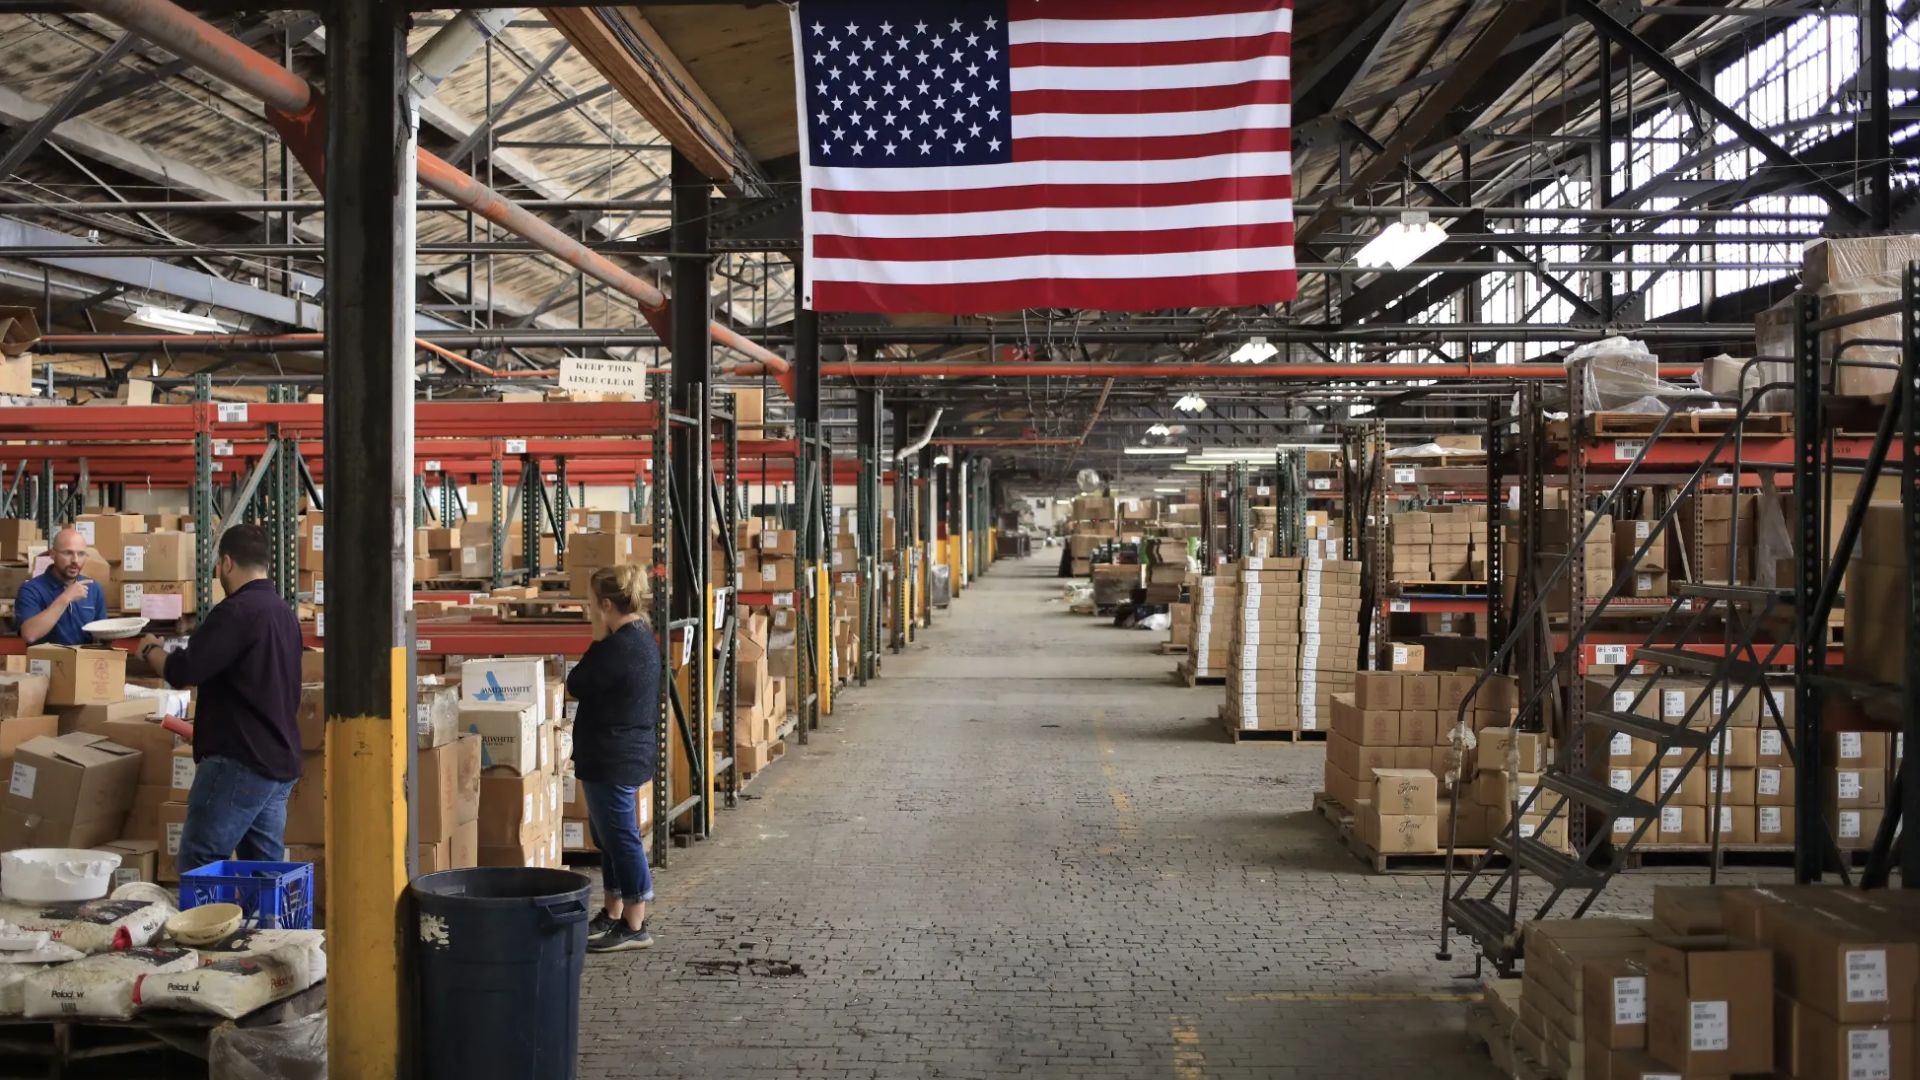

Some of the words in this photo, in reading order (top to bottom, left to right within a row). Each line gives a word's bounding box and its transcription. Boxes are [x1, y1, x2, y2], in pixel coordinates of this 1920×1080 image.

[576, 362, 604, 371] KEEP
[607, 365, 632, 373] THIS
[568, 375, 597, 384] AISLE
[600, 378, 634, 387] CLEAR
